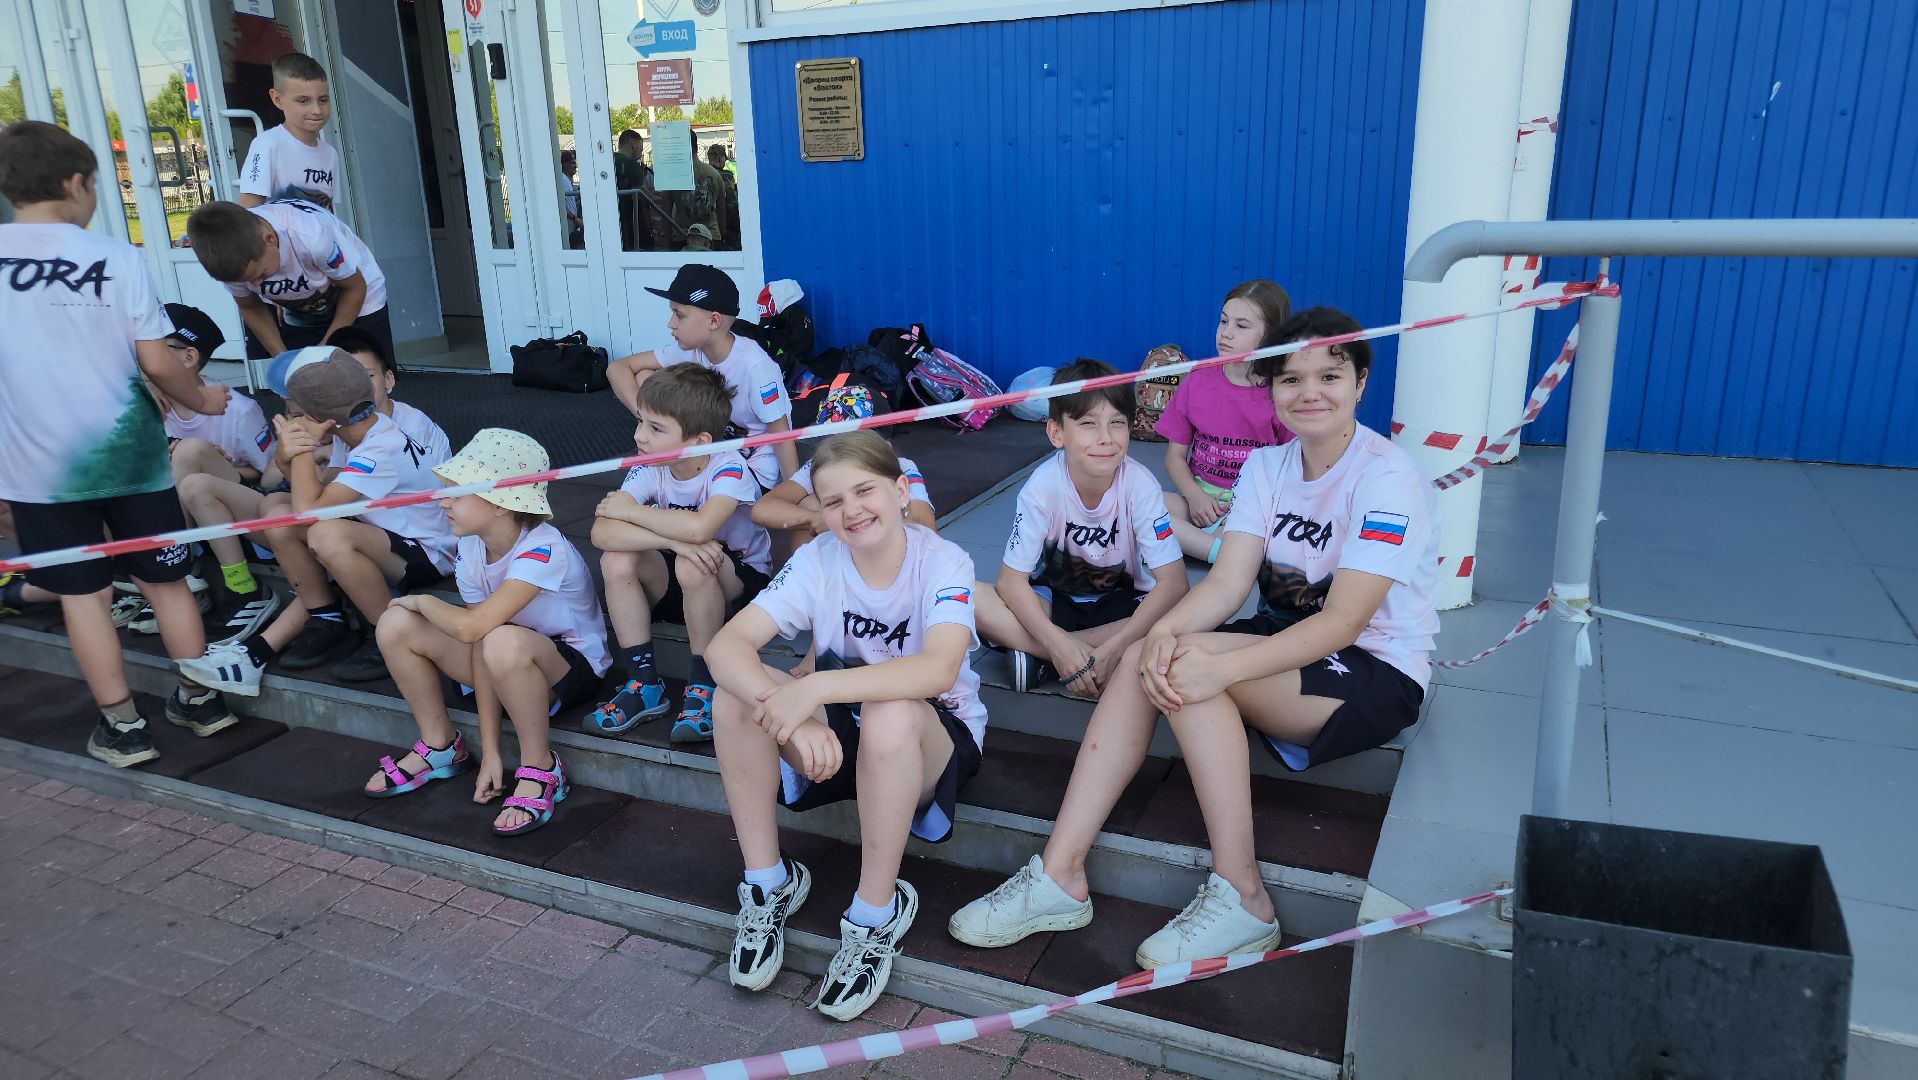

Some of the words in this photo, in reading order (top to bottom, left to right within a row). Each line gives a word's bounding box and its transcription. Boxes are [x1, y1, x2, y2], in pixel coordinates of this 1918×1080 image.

[661, 28, 688, 41] ВХОД
[304, 167, 333, 187] TORA
[260, 275, 311, 296] TORA
[177, 327, 199, 342] NIKE
[1209, 445, 1249, 459] BLOSSO
[1272, 510, 1332, 553] TORA
